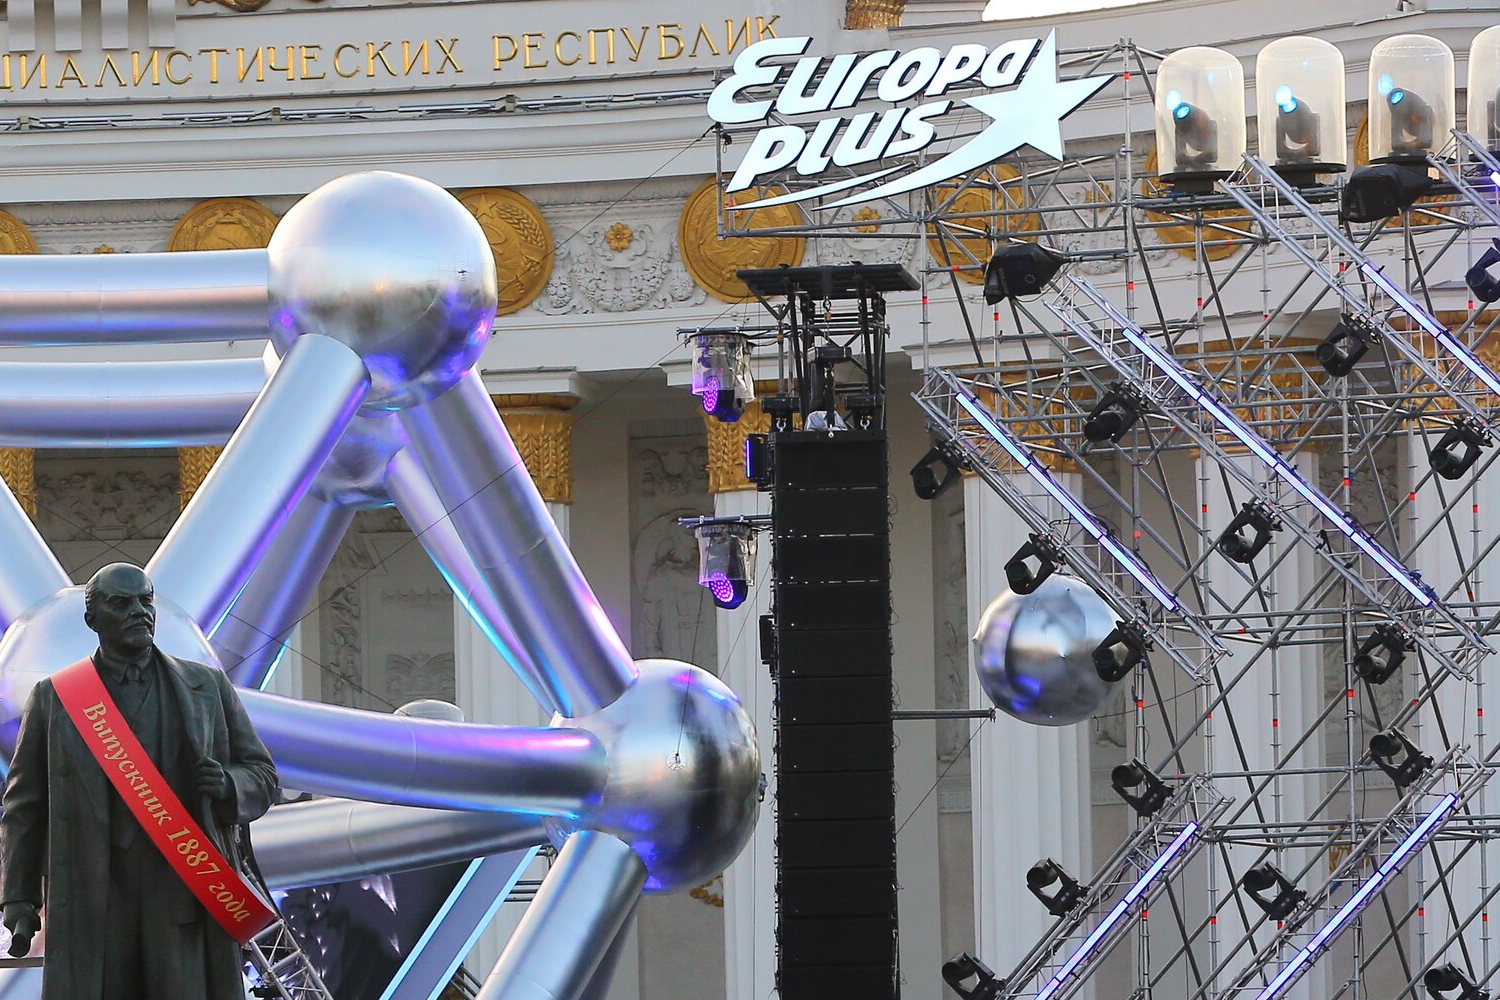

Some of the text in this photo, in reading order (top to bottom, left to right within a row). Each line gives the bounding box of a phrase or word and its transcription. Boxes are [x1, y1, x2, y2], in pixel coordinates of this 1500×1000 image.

[492, 15, 780, 70] РЕСПУБЛИК
[82, 700, 251, 923] Выпускник 1887 года
